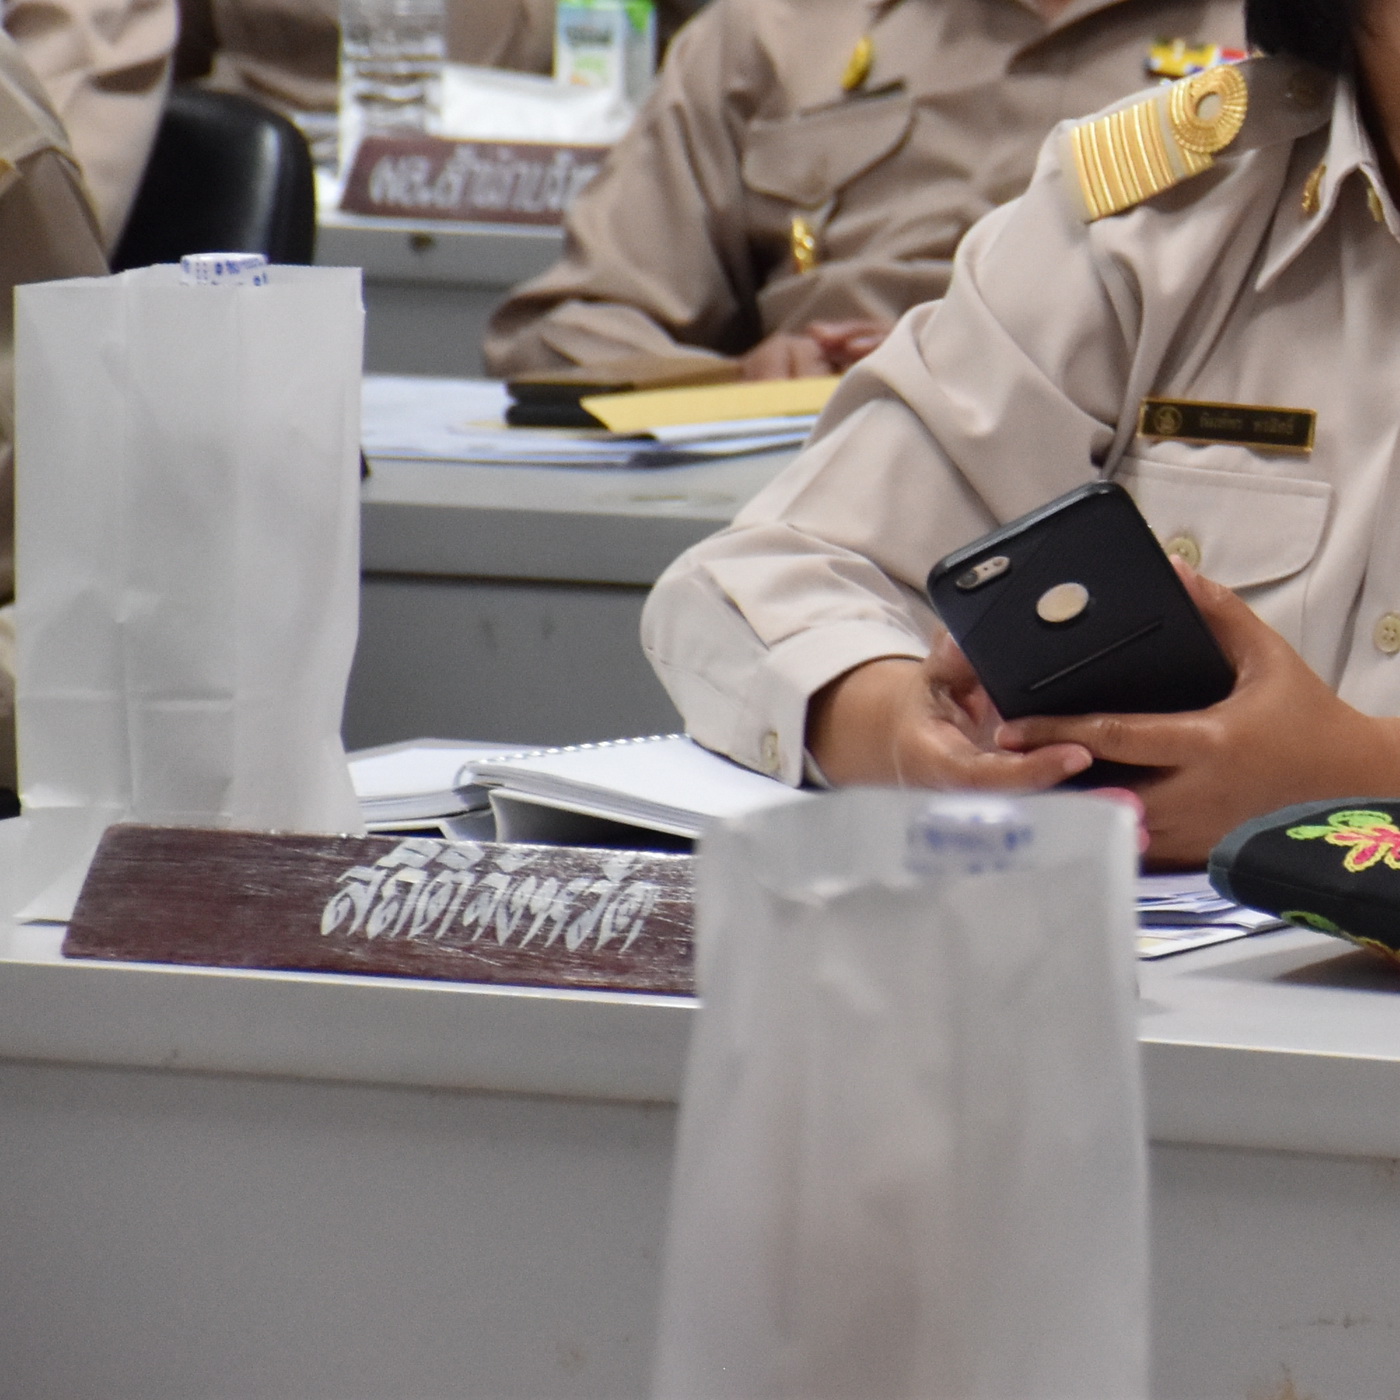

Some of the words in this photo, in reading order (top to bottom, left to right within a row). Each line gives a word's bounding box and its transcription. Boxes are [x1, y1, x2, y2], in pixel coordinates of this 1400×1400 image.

[320, 838, 662, 955] สถิติจังหวัด
